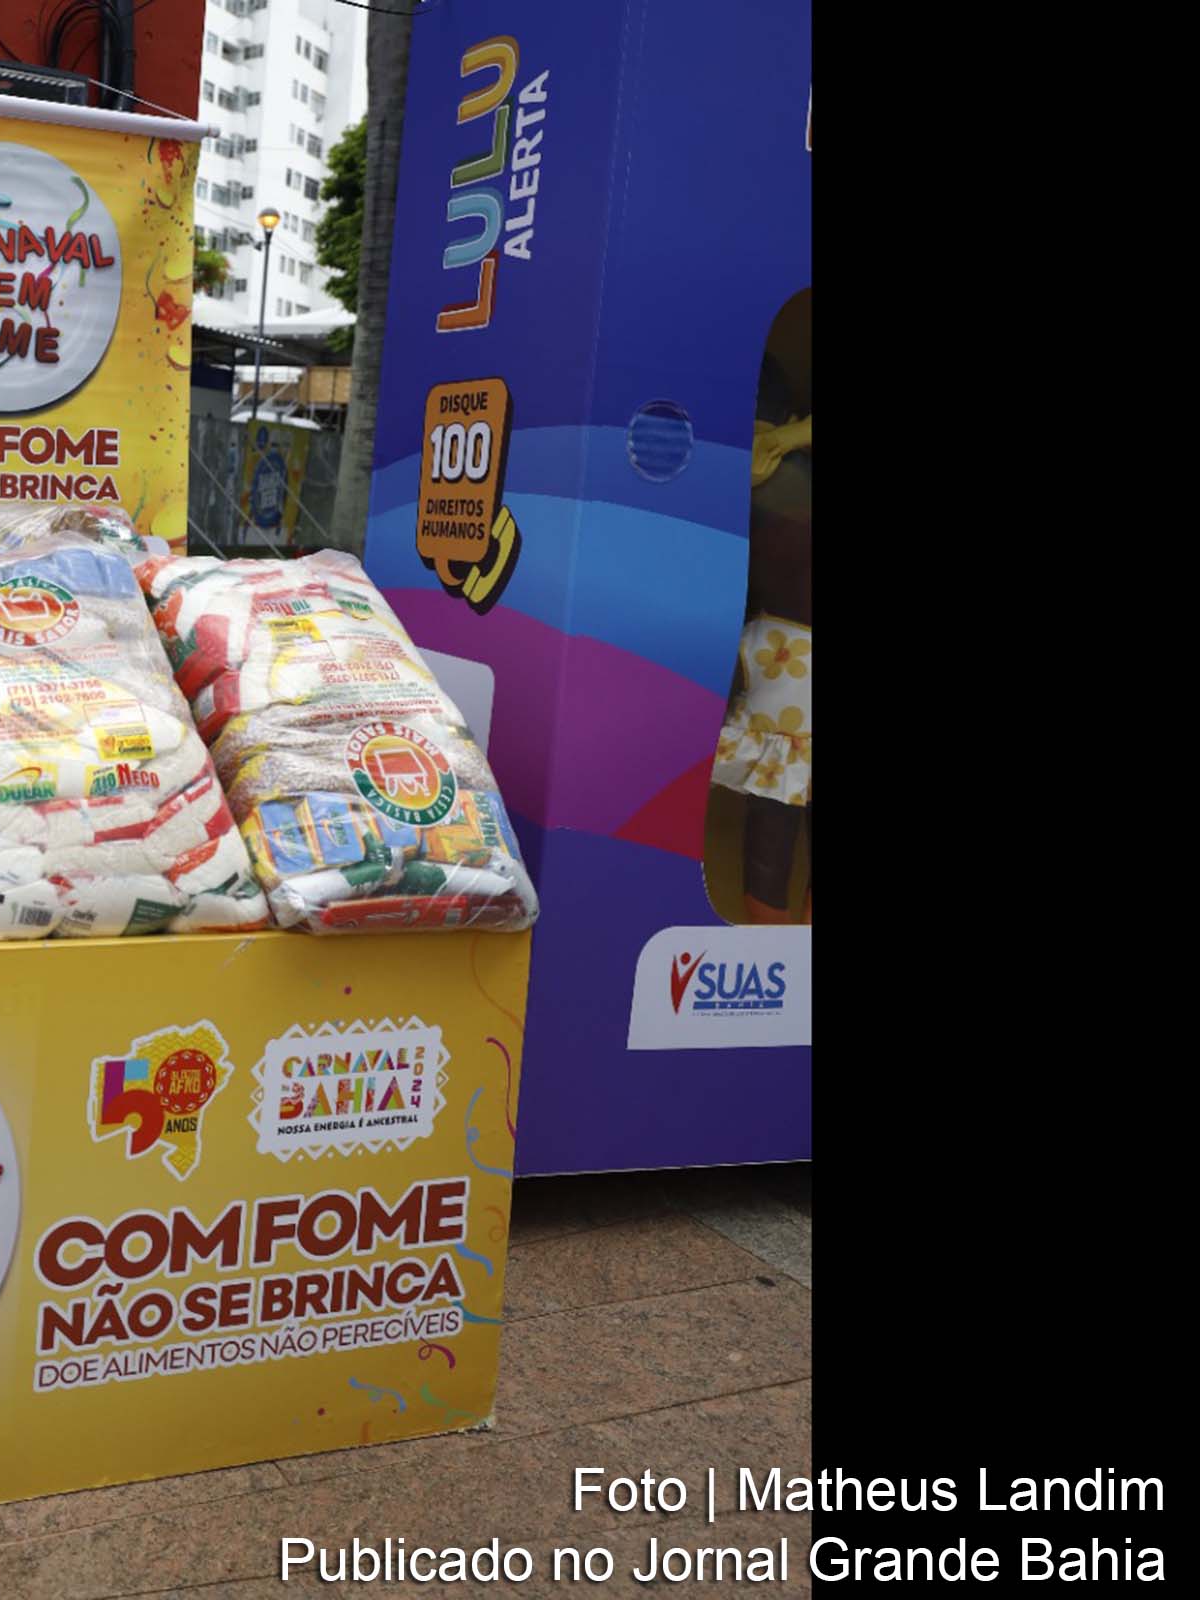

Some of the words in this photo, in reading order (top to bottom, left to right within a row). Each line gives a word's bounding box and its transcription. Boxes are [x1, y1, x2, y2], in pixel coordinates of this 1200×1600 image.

[435, 34, 520, 333] LULU
[504, 70, 550, 260] ALERTA
[439, 391, 488, 416] DISQUE
[430, 421, 492, 482] 100
[0, 472, 119, 500] BRINCA
[426, 499, 484, 517] DIREITOS
[421, 520, 485, 541] HUMANOS
[694, 962, 786, 999] SUAS
[282, 1047, 409, 1079] CARNAVAL
[410, 1046, 425, 1109] 2024
[279, 1076, 406, 1120] BAHIA
[165, 1117, 198, 1134] ANOS
[277, 1124, 311, 1136] NOSSA
[314, 1119, 356, 1132] ENERGIA
[358, 1117, 364, 1129] É
[366, 1114, 418, 1128] ANCESTRAL
[37, 1205, 243, 1287] COM
[253, 1180, 466, 1262] FOME
[40, 1282, 174, 1351] NÃO
[182, 1282, 251, 1332] SE
[260, 1257, 462, 1324] BRINCA
[37, 1357, 99, 1388] DOE
[102, 1337, 255, 1380] ALIMENTOS
[260, 1324, 318, 1358] NÃO
[322, 1310, 460, 1352] PERECÍVEIS
